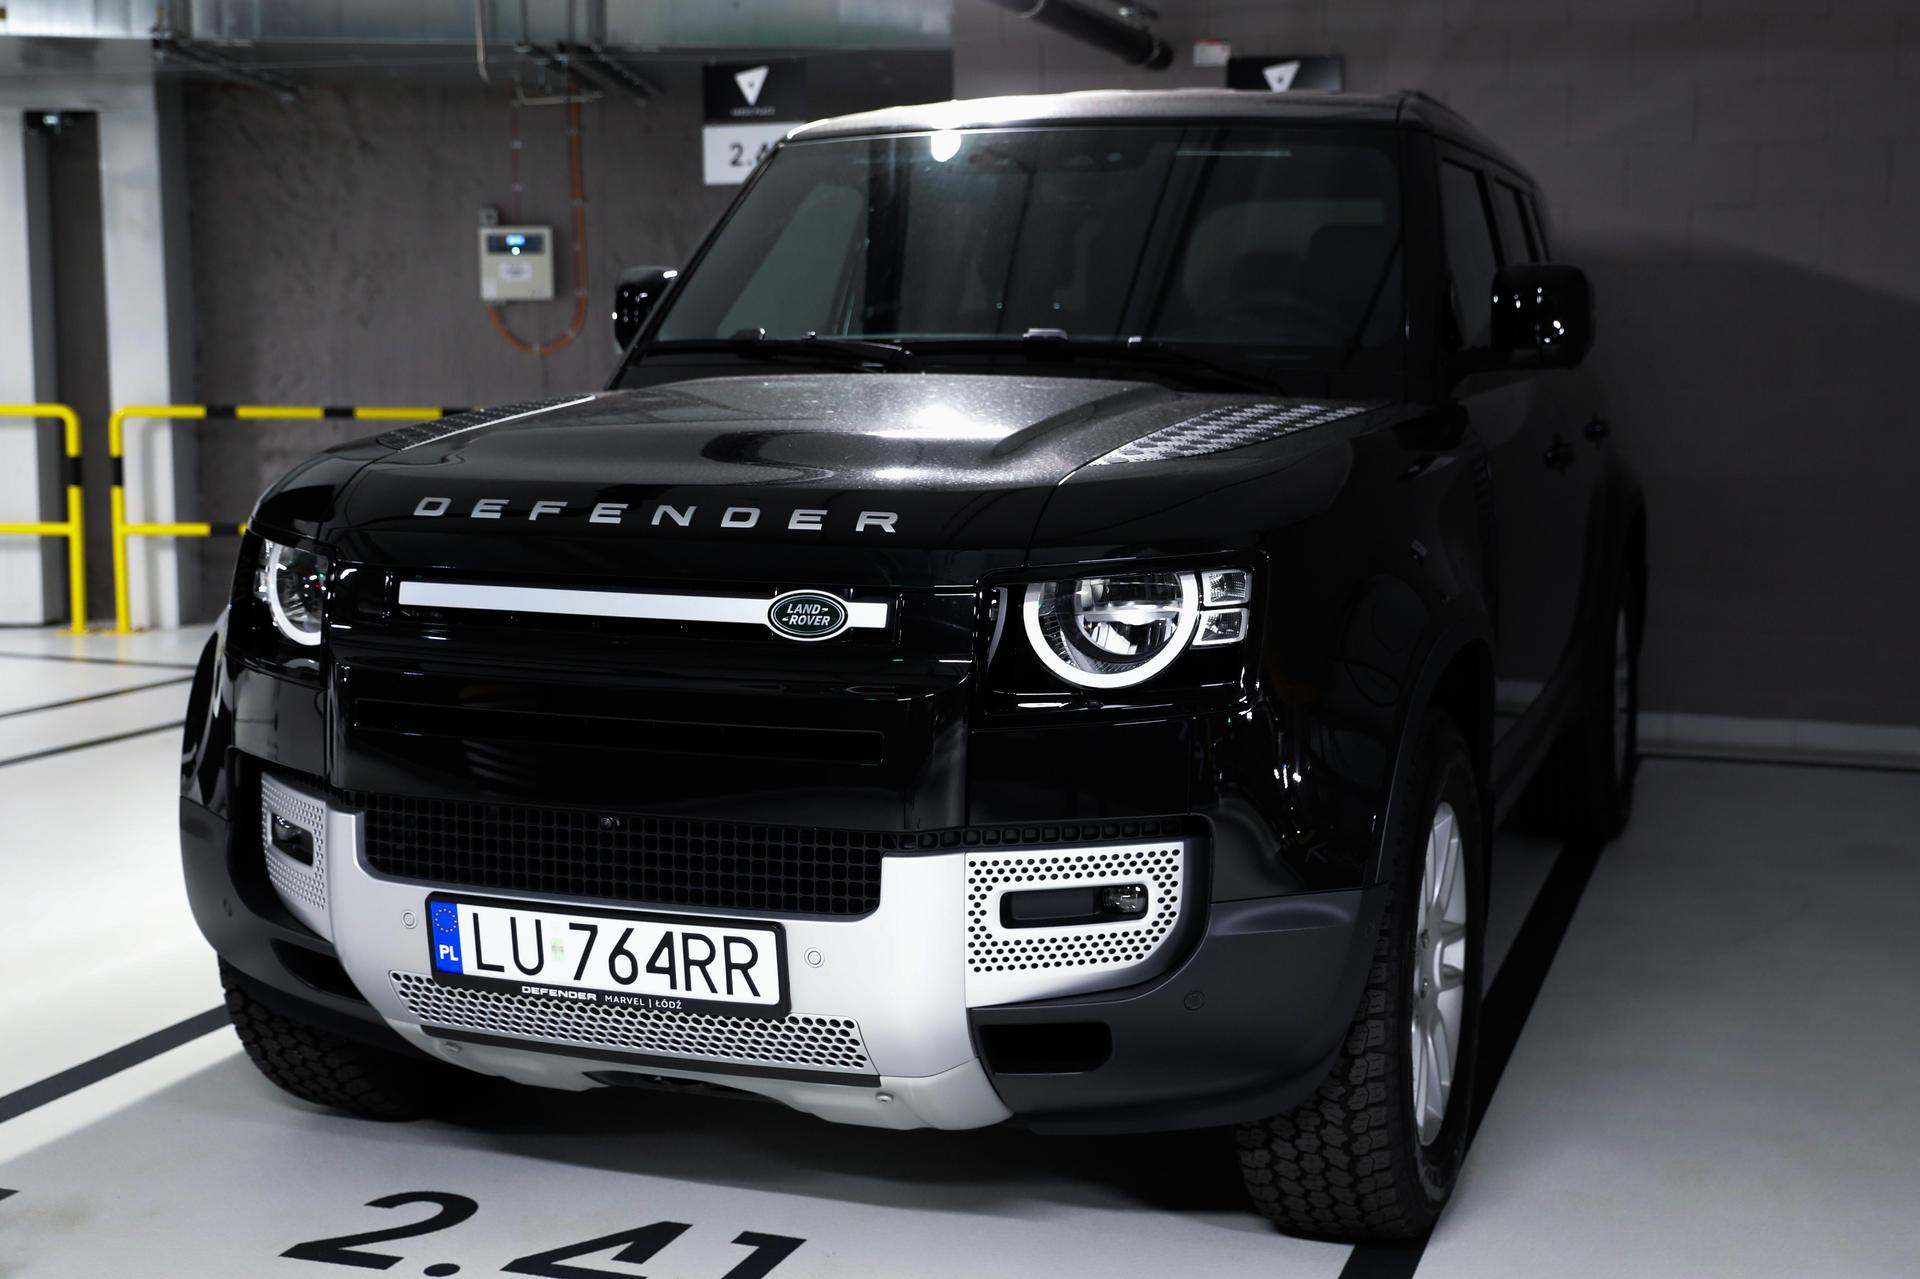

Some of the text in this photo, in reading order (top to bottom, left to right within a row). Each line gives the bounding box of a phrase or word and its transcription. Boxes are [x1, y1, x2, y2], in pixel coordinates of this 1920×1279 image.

[413, 496, 899, 533] DEFENDER
[439, 944, 459, 961] PL
[521, 985, 597, 1001] DEFENDER
[604, 995, 646, 1006] MARVEL
[655, 999, 683, 1010] ŁÓDŹ
